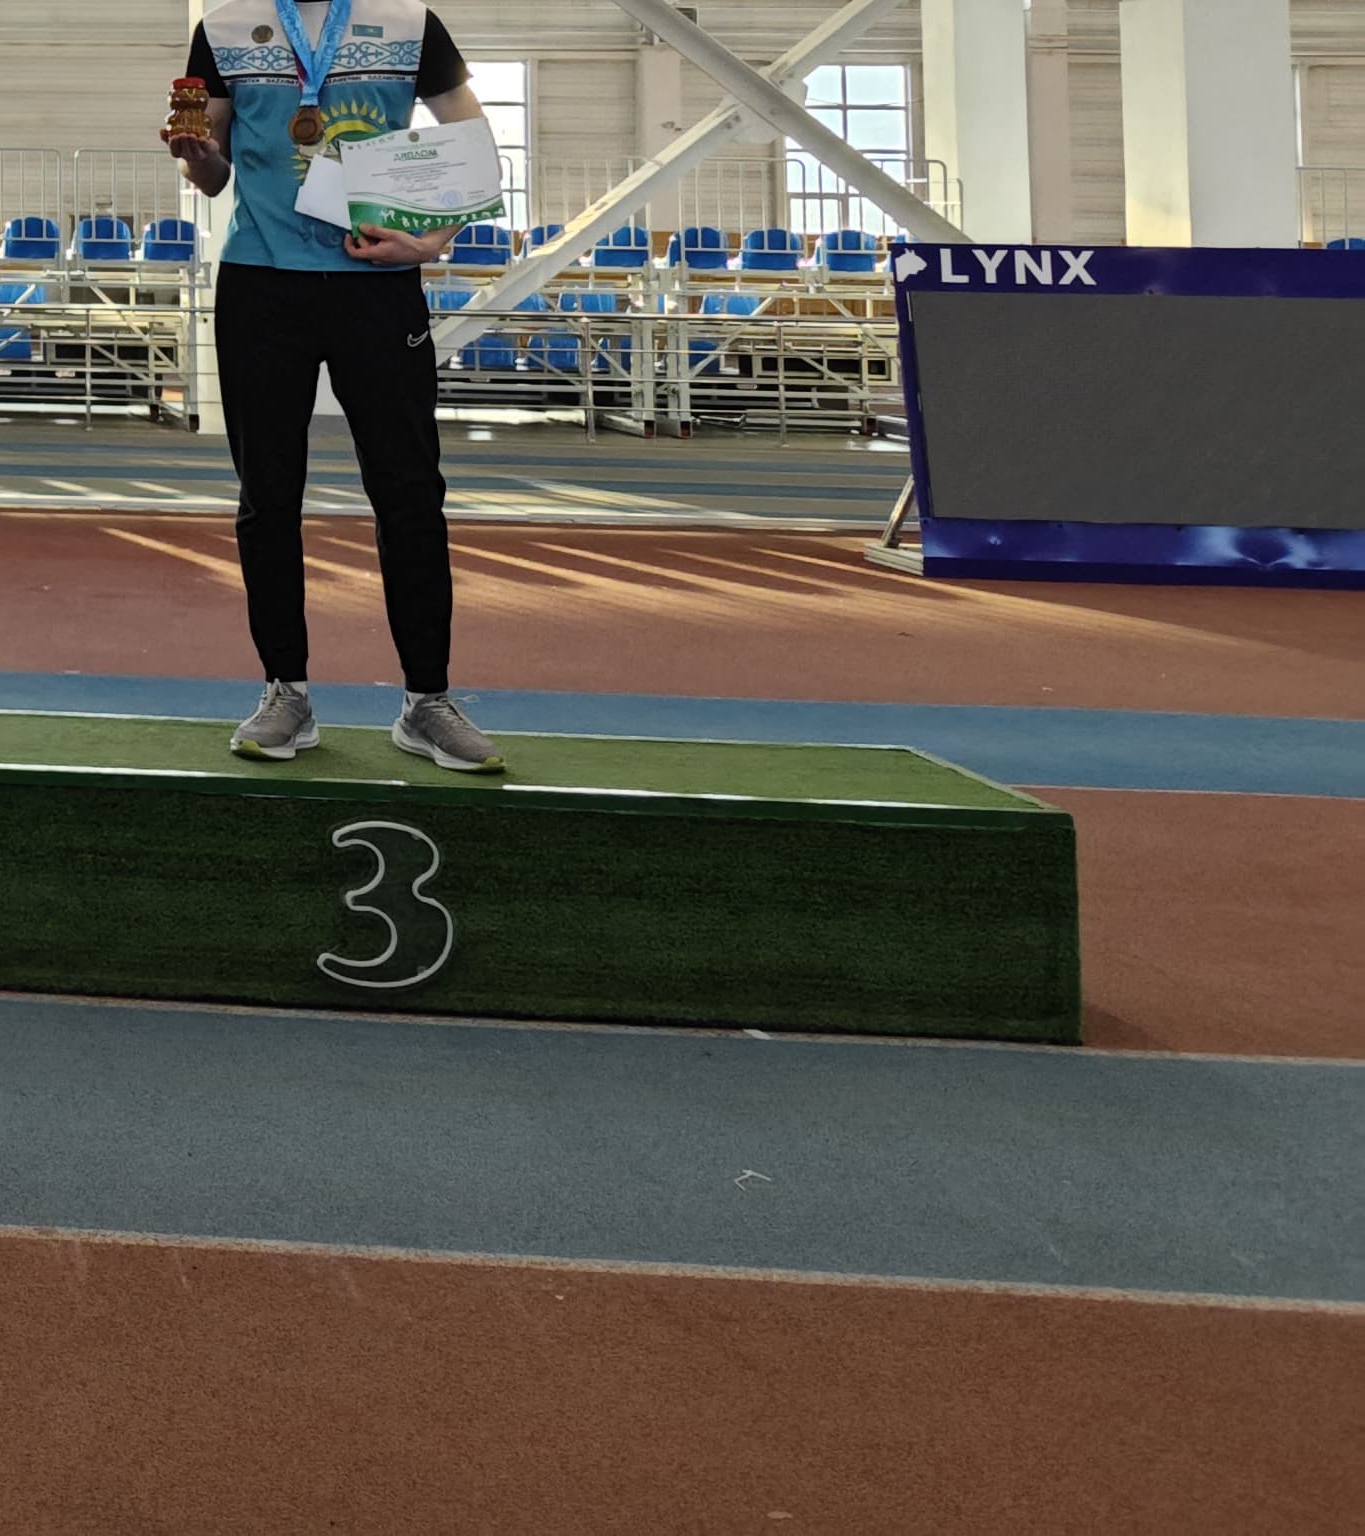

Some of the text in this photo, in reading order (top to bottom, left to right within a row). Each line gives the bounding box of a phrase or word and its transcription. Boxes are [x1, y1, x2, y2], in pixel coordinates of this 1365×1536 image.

[393, 148, 439, 162] ДИПЛОМ
[939, 248, 1097, 286] LYNX
[317, 820, 453, 988] 3
